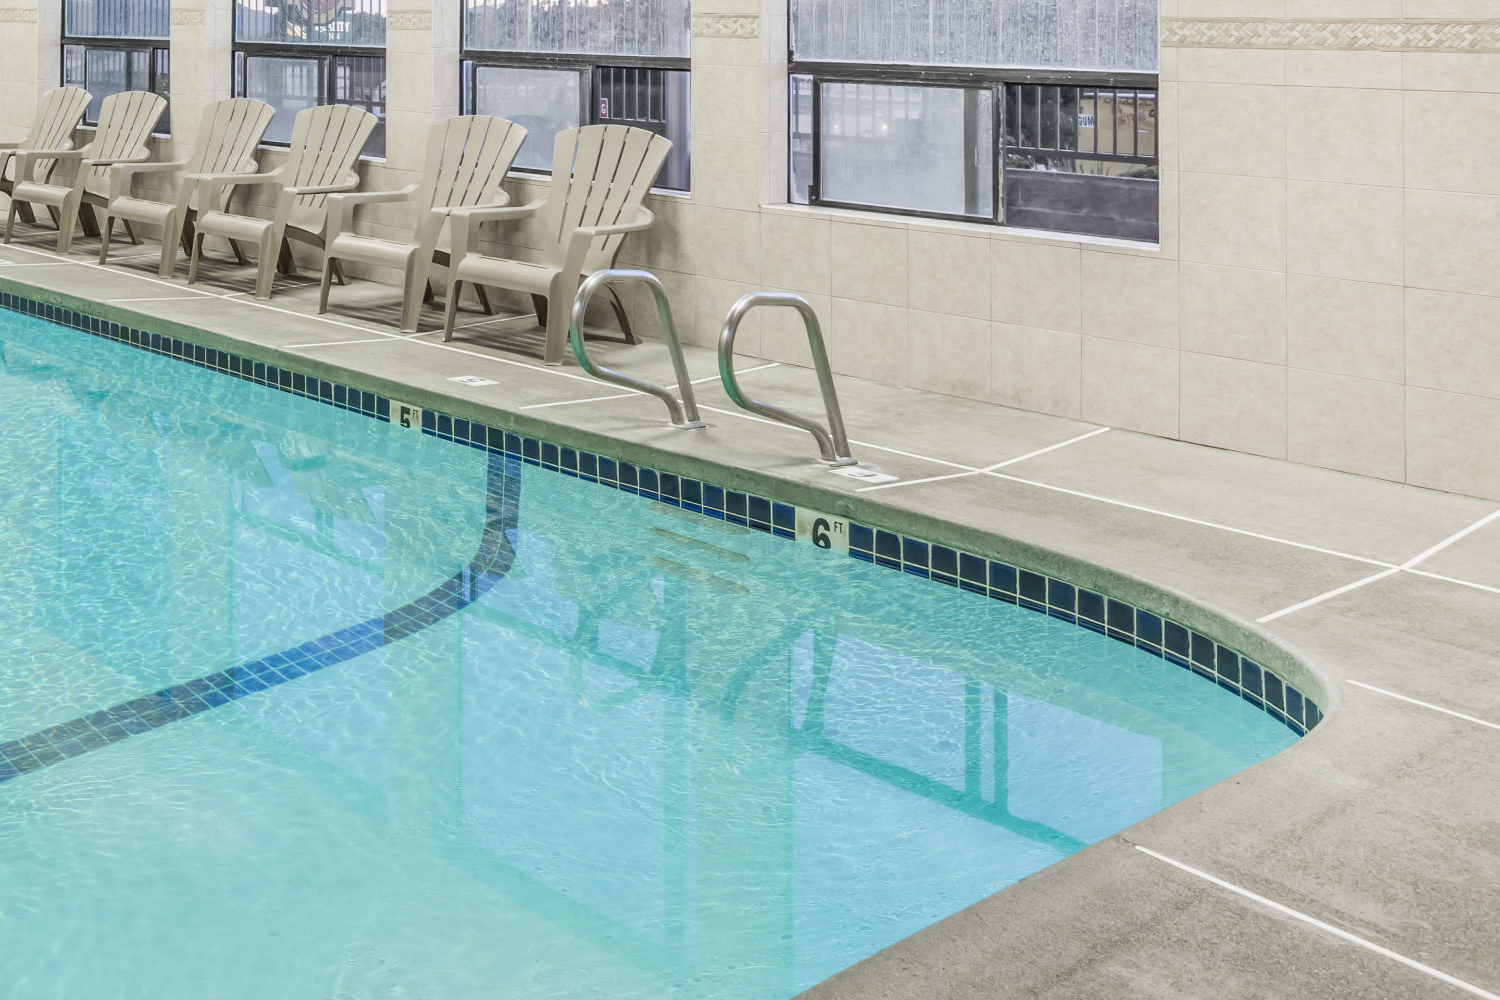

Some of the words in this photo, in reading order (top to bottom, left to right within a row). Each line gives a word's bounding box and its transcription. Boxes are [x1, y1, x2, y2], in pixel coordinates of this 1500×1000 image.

[400, 405, 411, 429] 5
[812, 517, 831, 550] 6
[834, 521, 843, 534] FT
